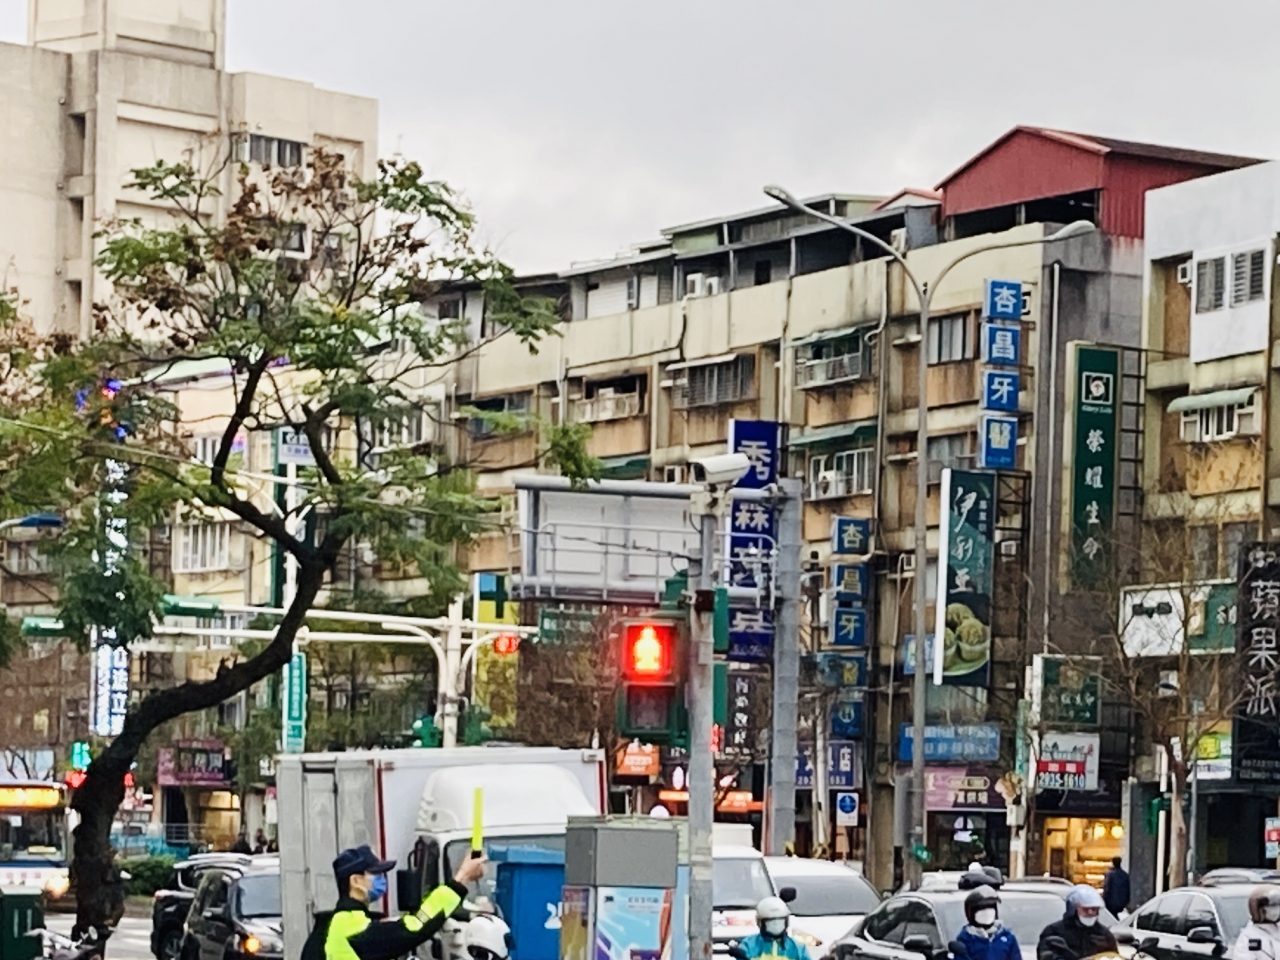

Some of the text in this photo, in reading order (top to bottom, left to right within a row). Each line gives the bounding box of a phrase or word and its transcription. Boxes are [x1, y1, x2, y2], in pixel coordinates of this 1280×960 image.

[988, 285, 1017, 450] 杏昌牙醫
[1246, 579, 1280, 716] 蘋果派
